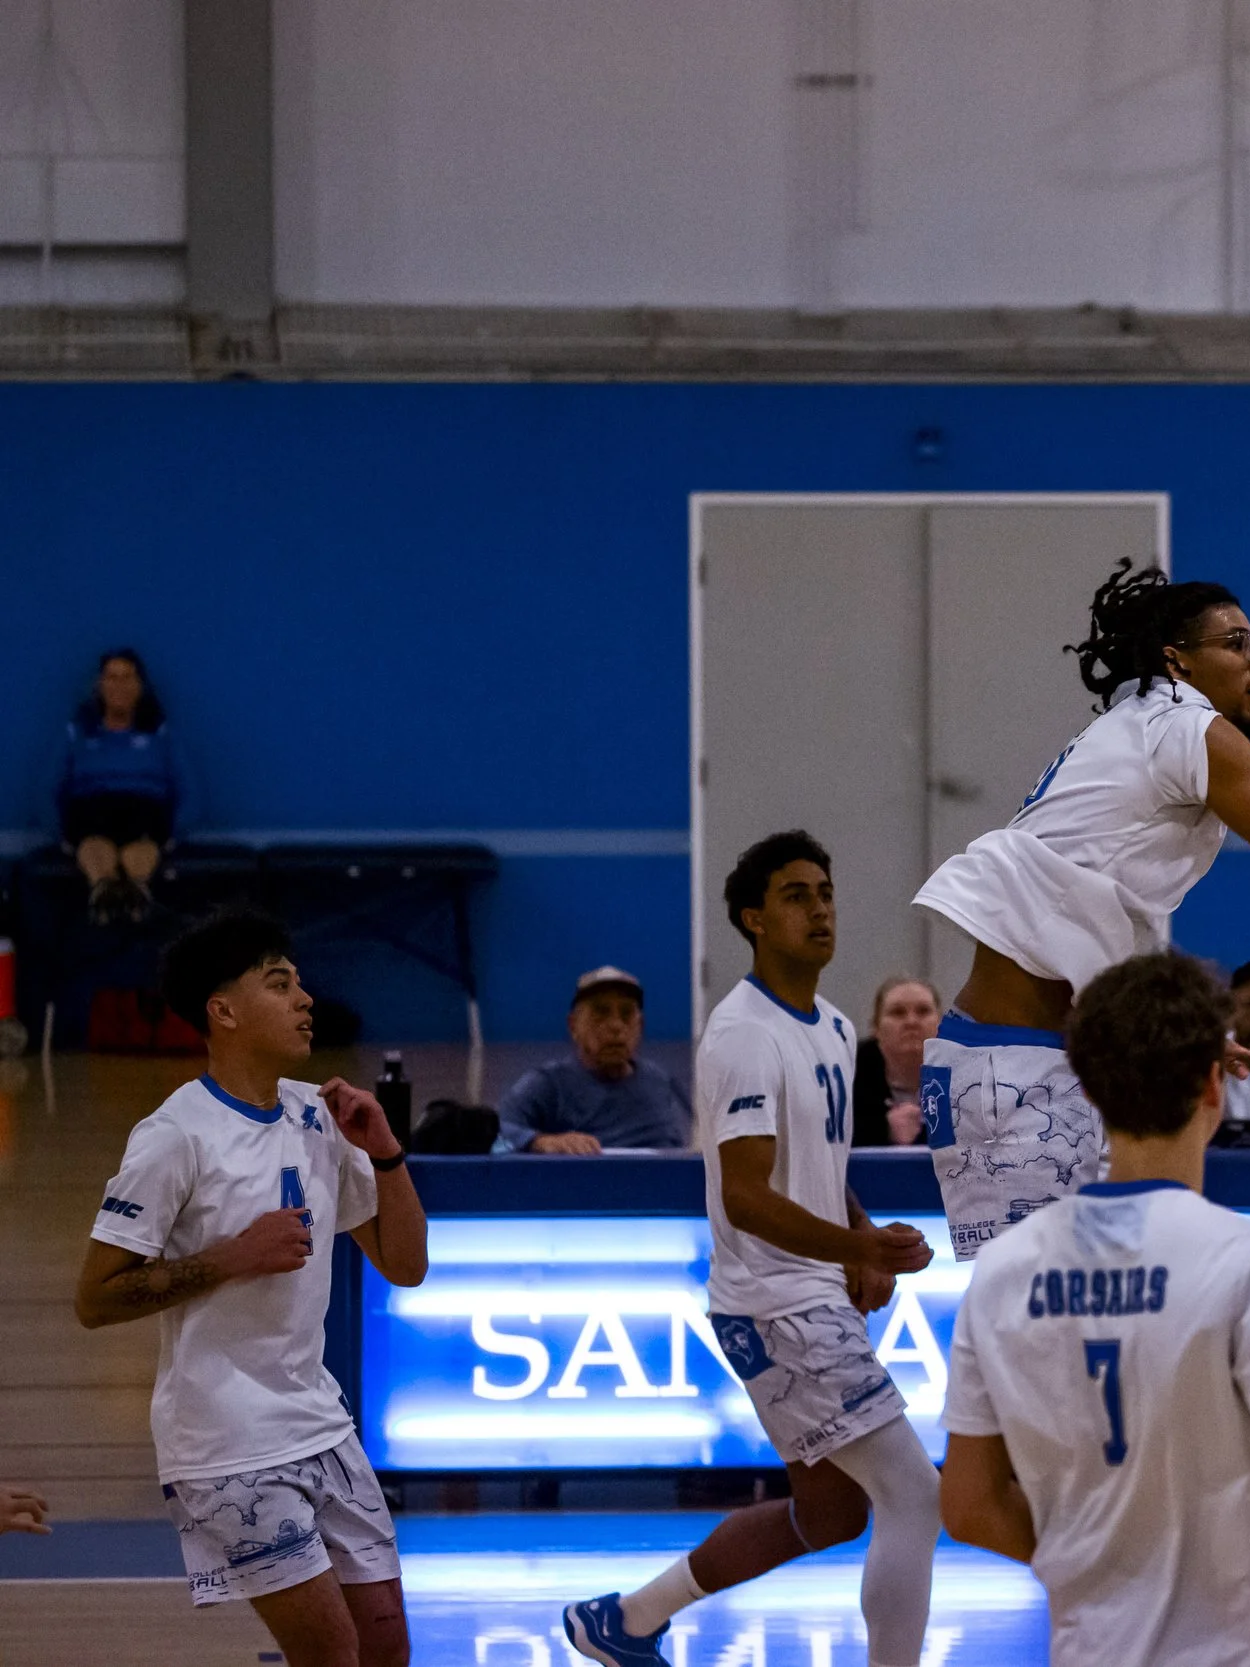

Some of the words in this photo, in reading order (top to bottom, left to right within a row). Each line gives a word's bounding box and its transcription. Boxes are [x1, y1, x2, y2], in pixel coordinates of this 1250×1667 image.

[958, 1220, 996, 1231] COLLEGE
[471, 1290, 948, 1401] SANA
[1083, 1338, 1128, 1467] 7
